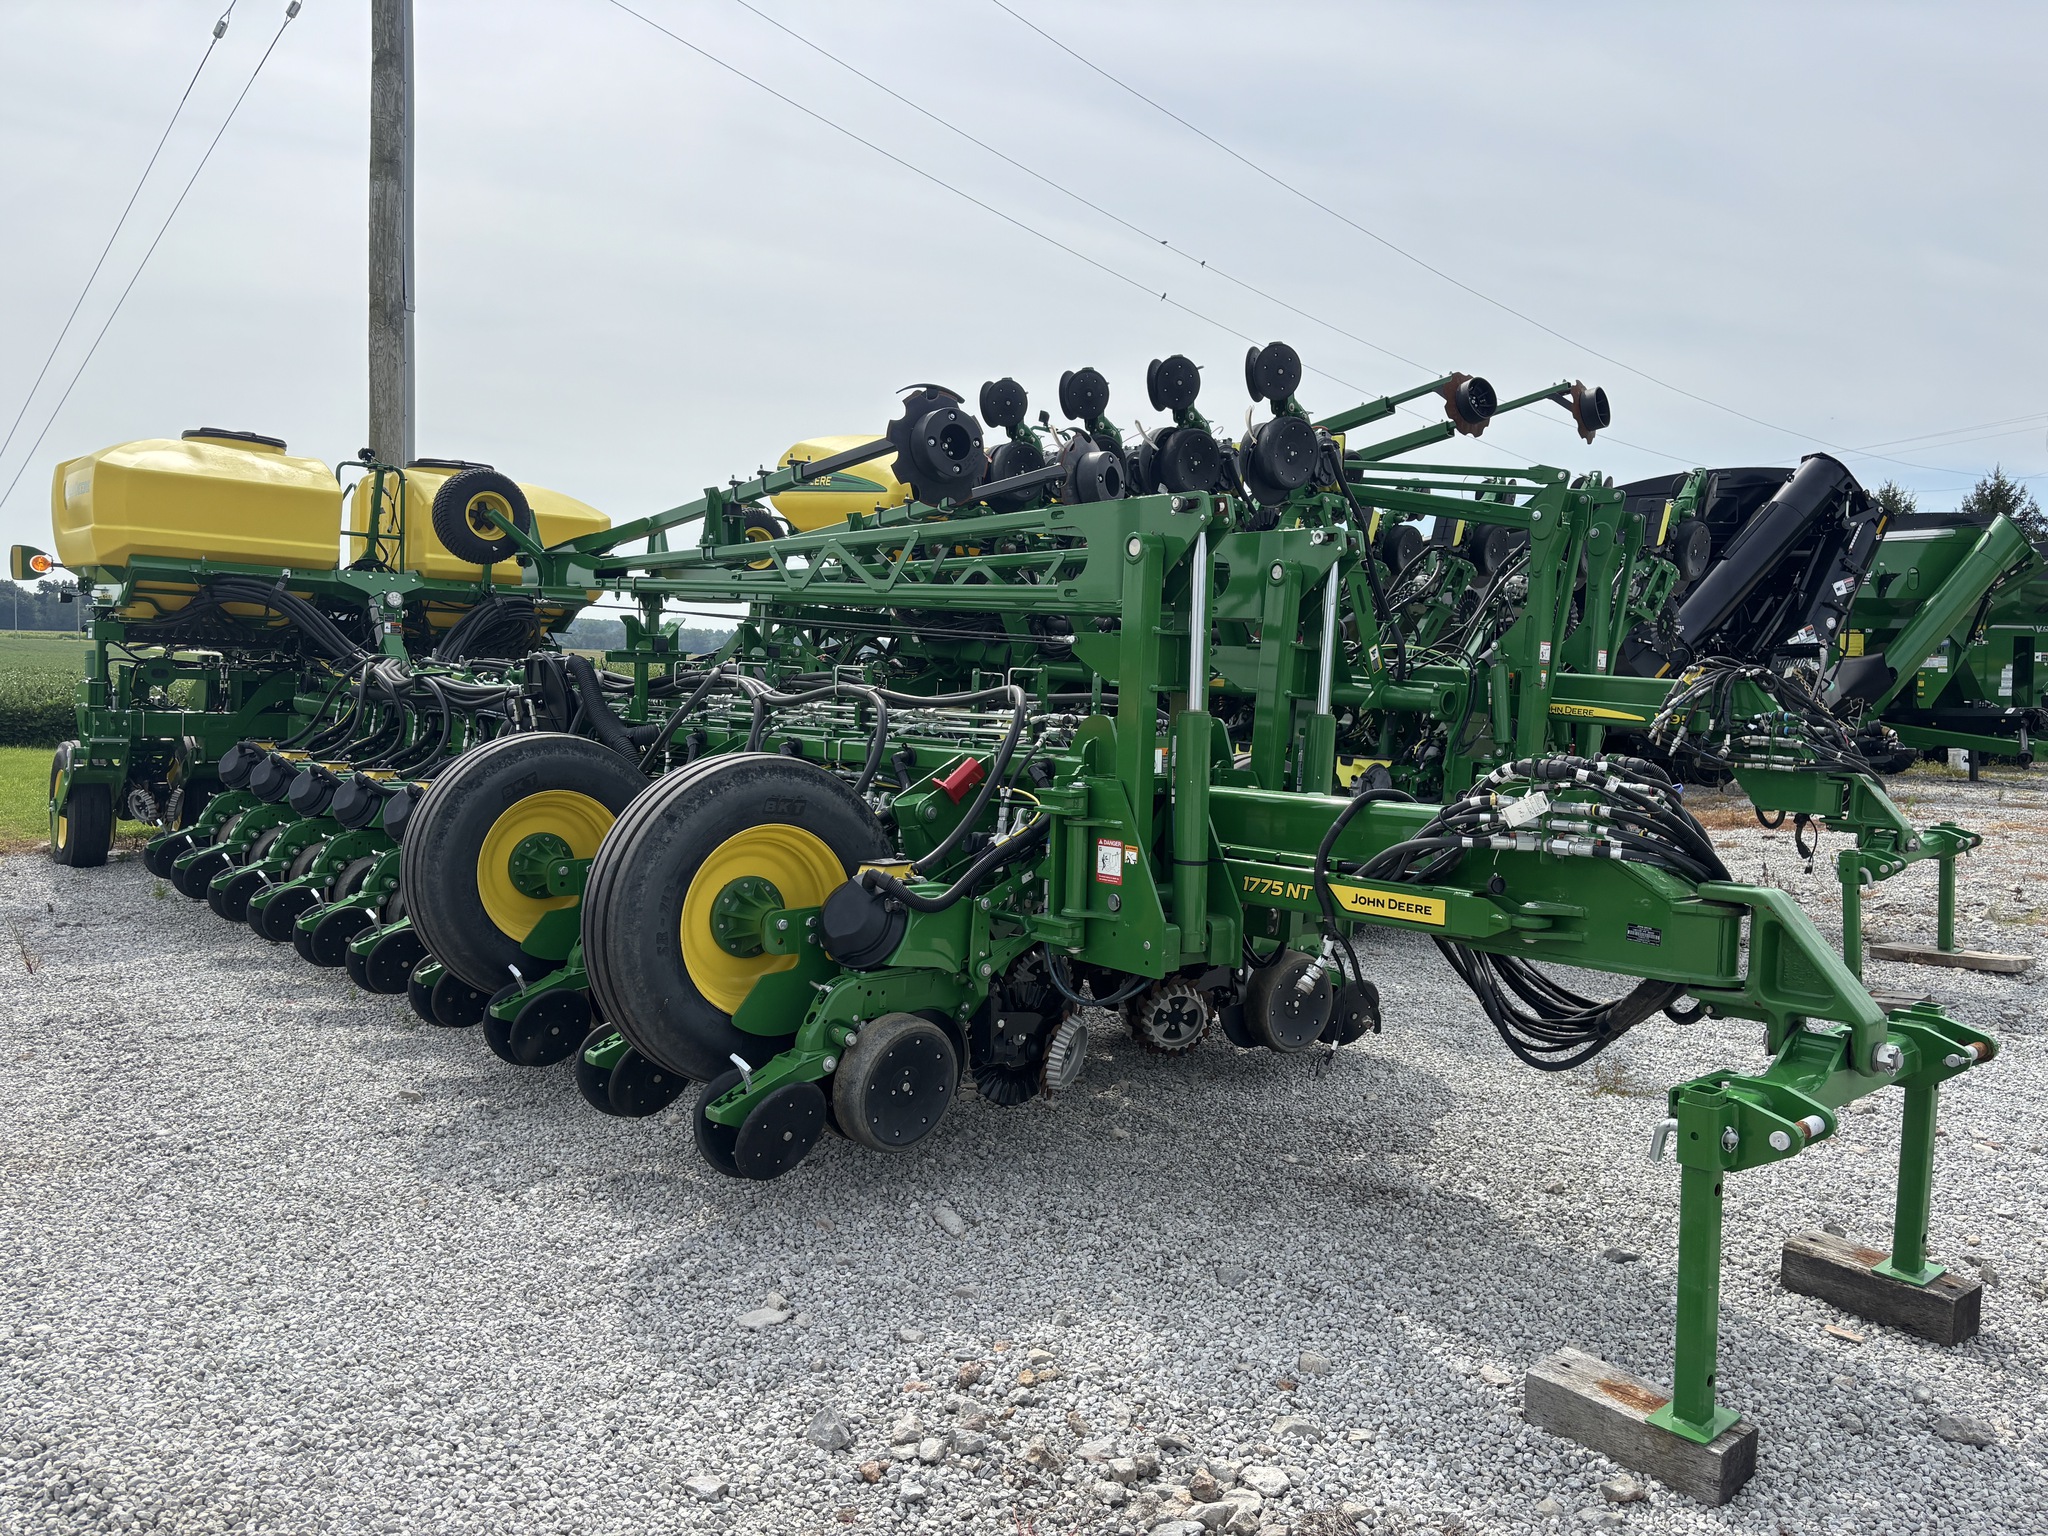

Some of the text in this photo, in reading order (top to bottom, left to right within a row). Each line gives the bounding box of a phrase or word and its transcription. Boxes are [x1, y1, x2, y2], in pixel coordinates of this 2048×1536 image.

[1565, 706, 1595, 716] DEERE
[763, 798, 807, 816] BKT
[1103, 839, 1122, 847] DANGER
[1243, 876, 1314, 900] 1775 NT
[1351, 893, 1432, 915] JOHN DEERE
